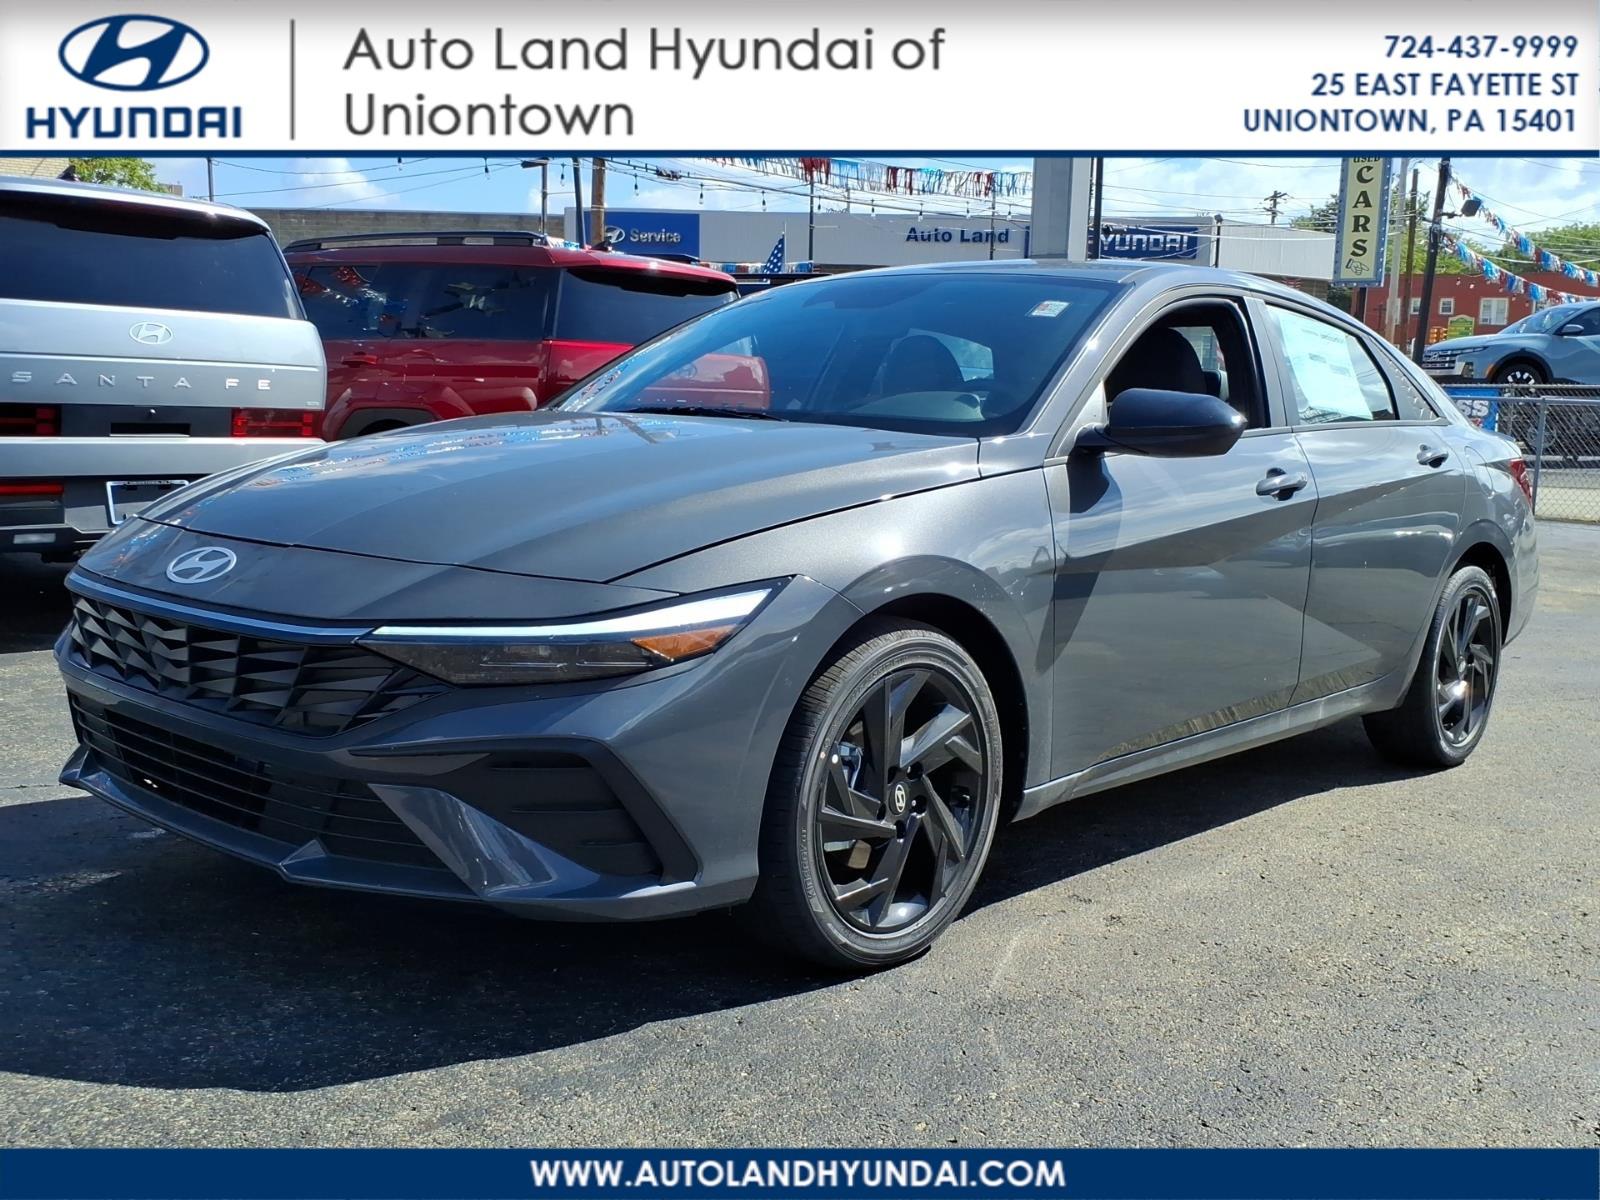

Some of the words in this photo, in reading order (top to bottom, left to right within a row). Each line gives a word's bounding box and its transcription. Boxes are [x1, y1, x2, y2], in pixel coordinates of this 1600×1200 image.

[1350, 165, 1374, 257] CARS
[630, 228, 681, 242] Service
[905, 227, 952, 242] Auto
[960, 229, 1009, 243] Land
[1100, 233, 1188, 251] YUNDAI
[12, 371, 192, 389] SANTA
[225, 378, 271, 391] FE
